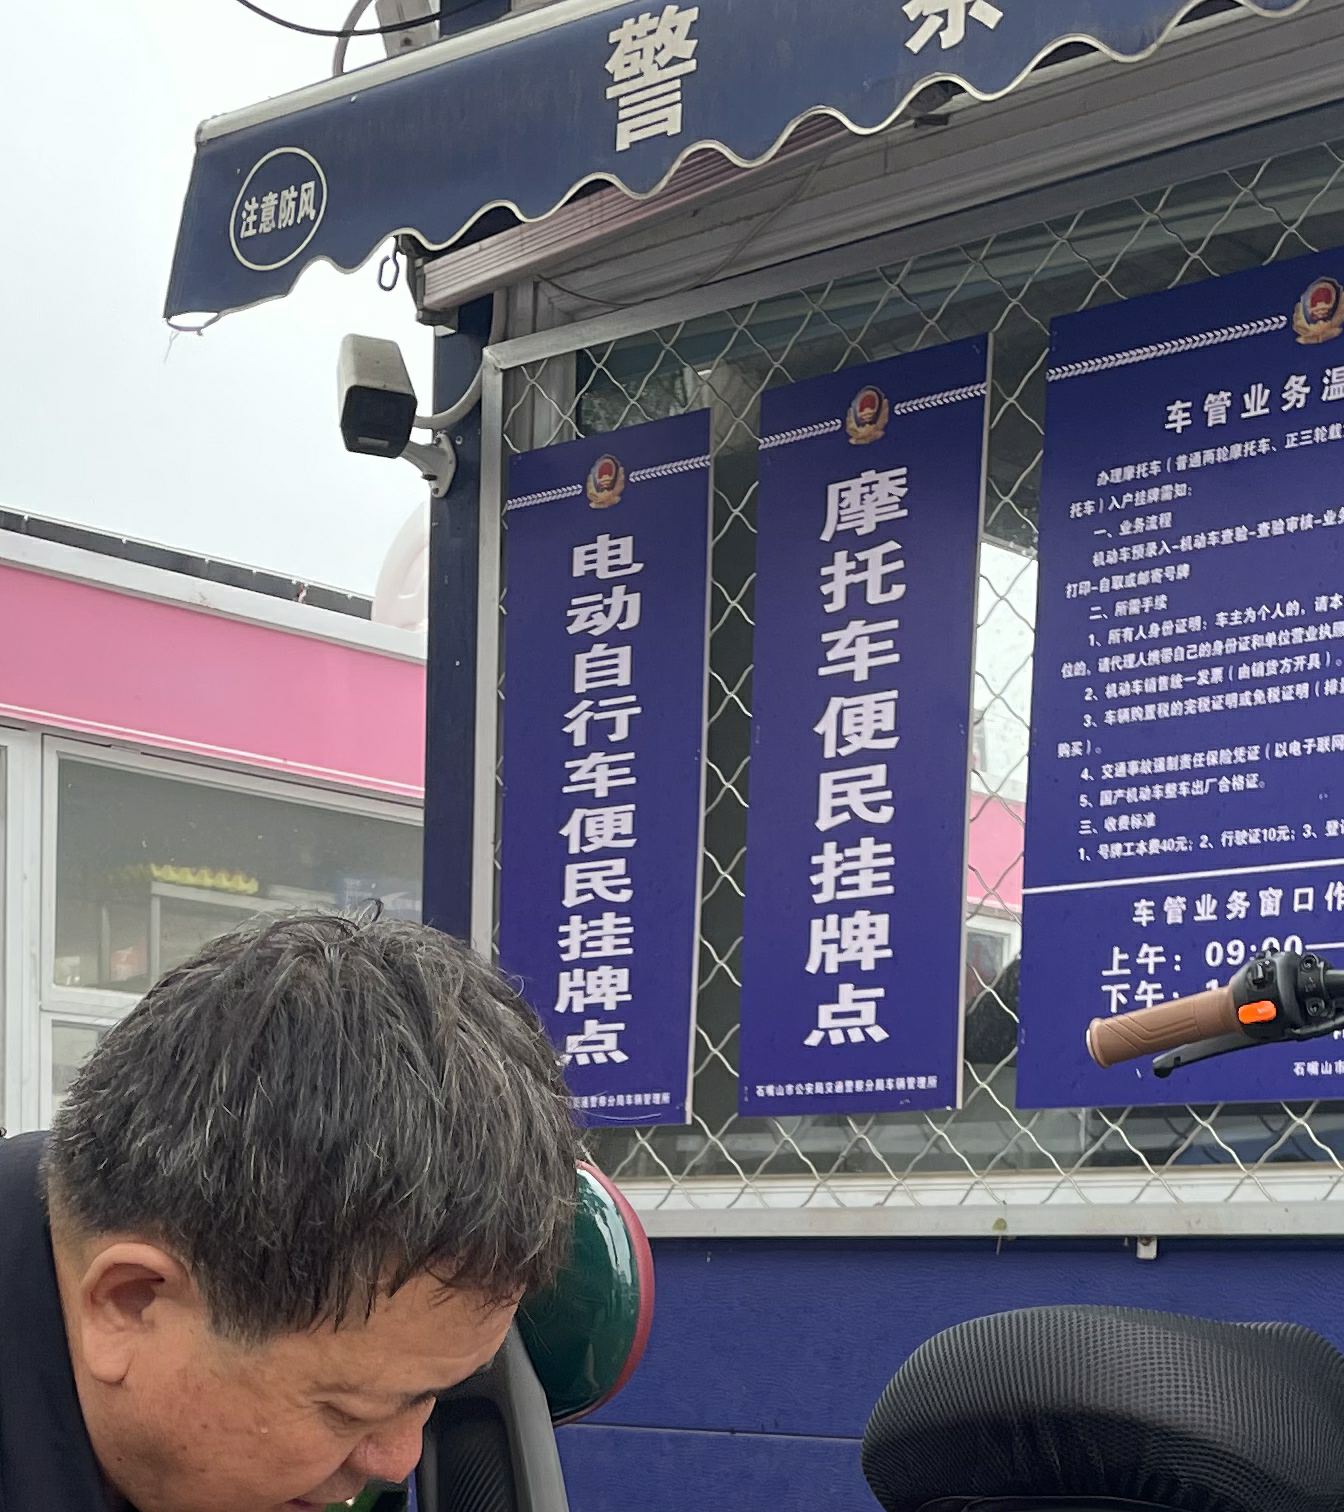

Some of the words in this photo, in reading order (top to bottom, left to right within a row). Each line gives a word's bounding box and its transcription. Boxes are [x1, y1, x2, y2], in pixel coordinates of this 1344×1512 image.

[239, 180, 317, 241] 注意防风
[604, 5, 702, 153] 警
[553, 533, 645, 1066] 电动自行车便民挂牌点
[803, 466, 909, 1047] 摩托车便民挂牌点
